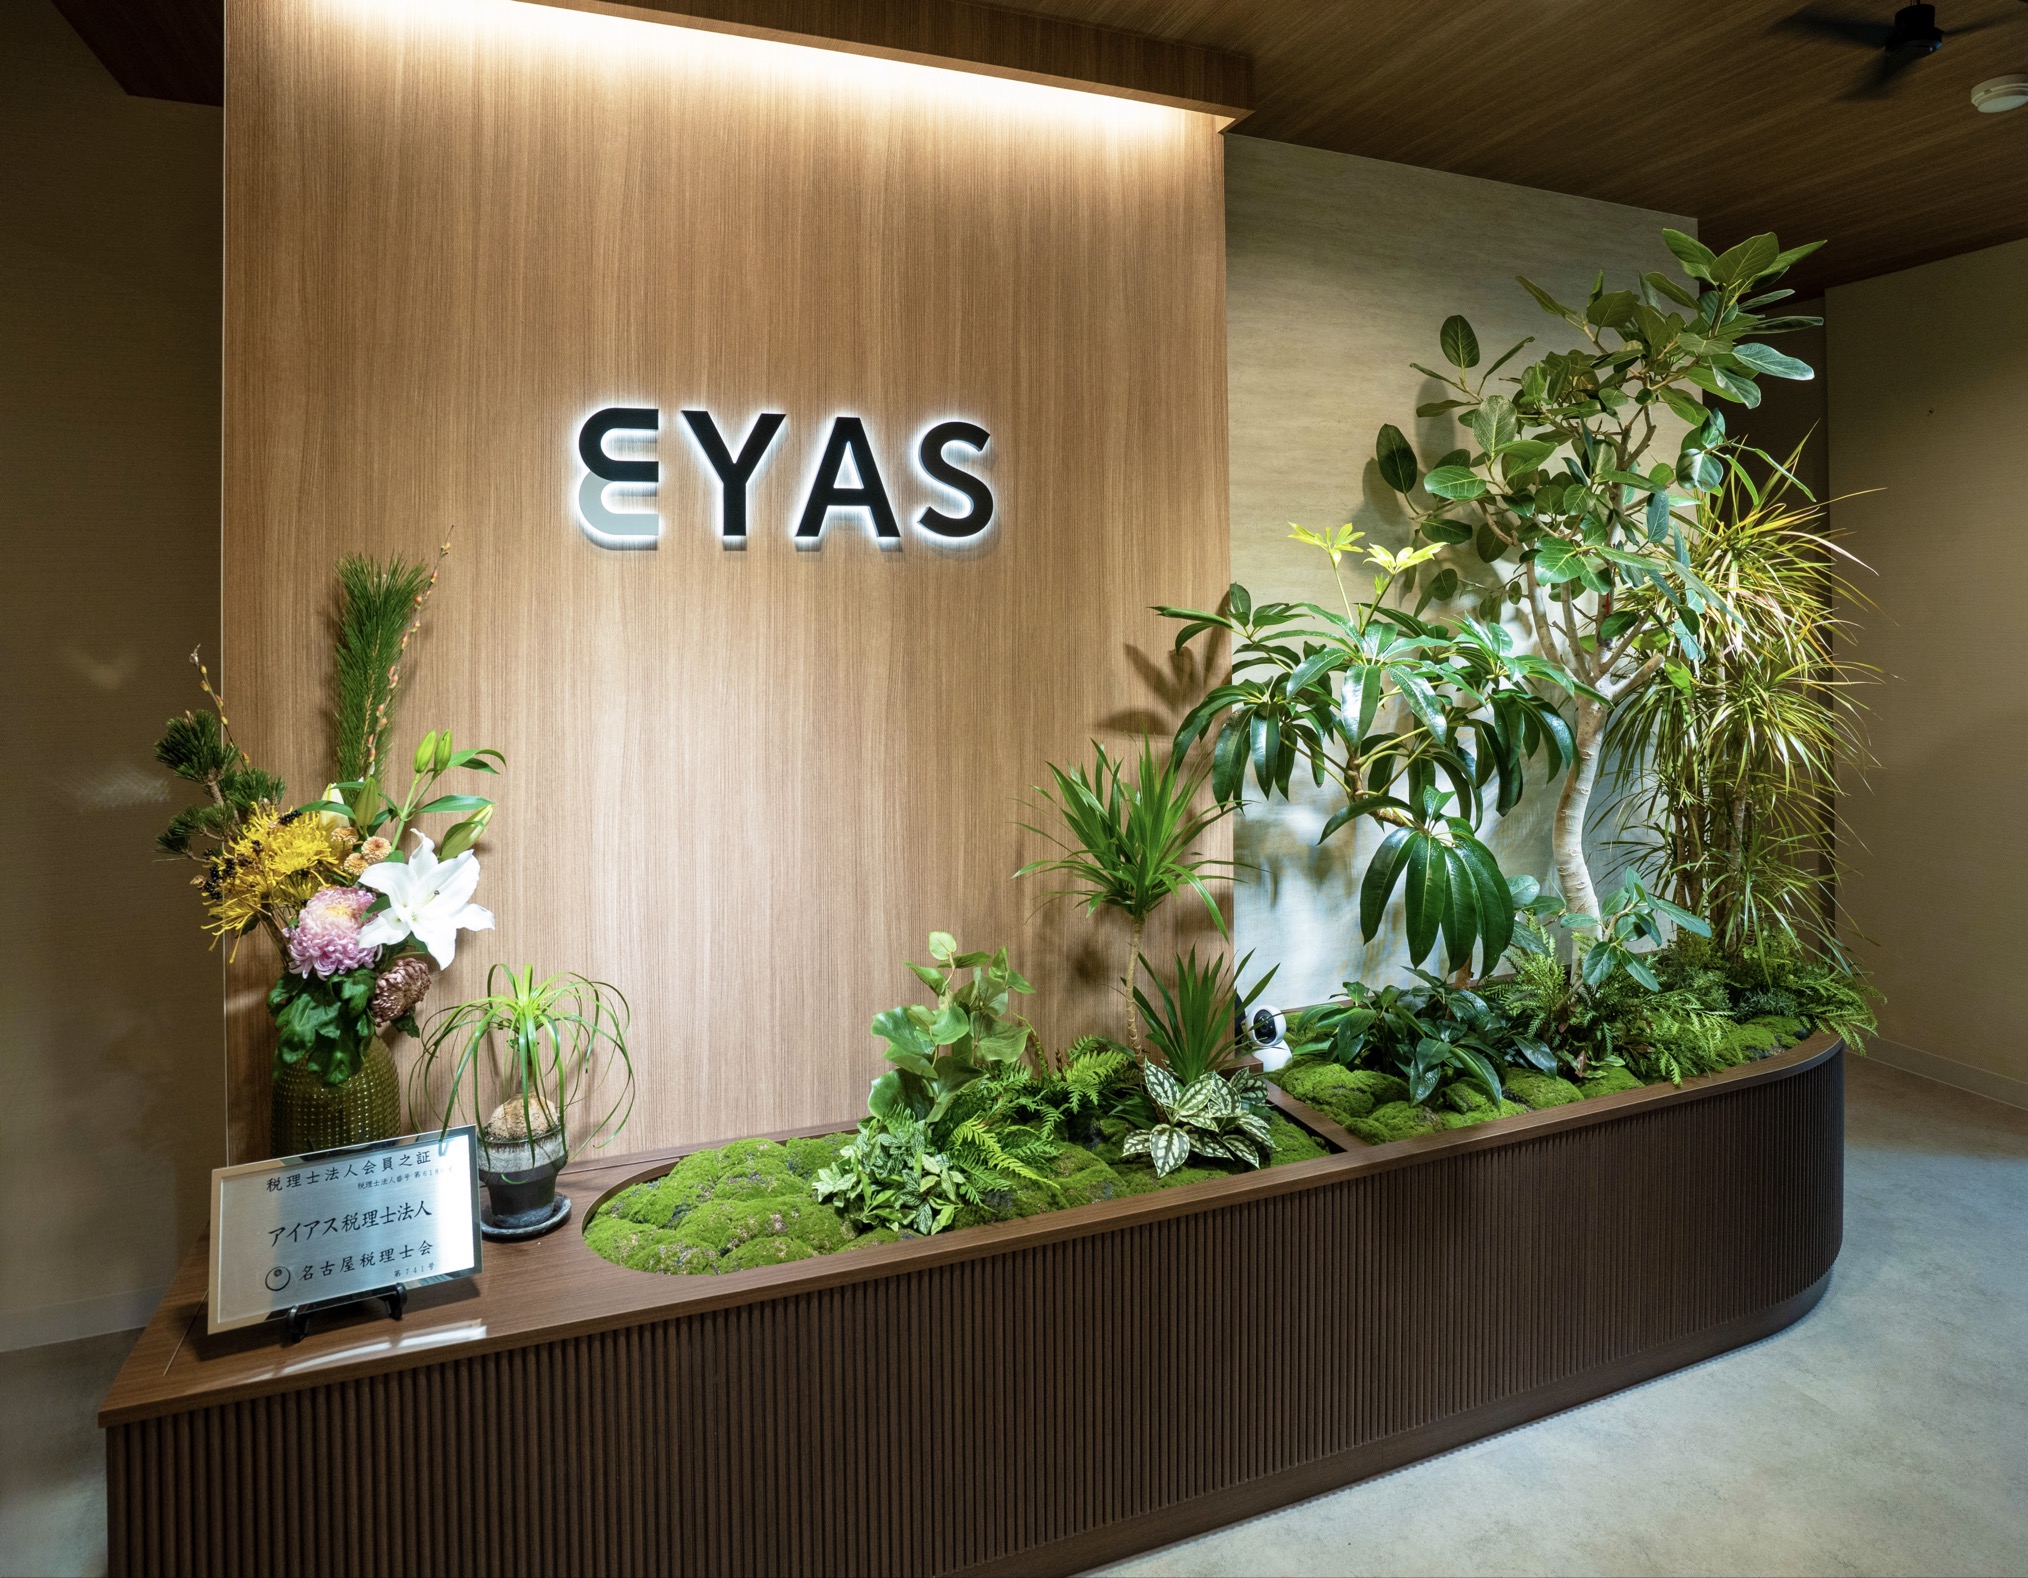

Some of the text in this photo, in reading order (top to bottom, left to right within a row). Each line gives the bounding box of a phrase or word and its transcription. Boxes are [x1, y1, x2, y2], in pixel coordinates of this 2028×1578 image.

[580, 408, 993, 538] EYAS
[267, 1151, 431, 1192] 税理士法人会員之証
[269, 1200, 432, 1247] アイアス税理士法人
[299, 1241, 432, 1281] 名古屋税理士会
